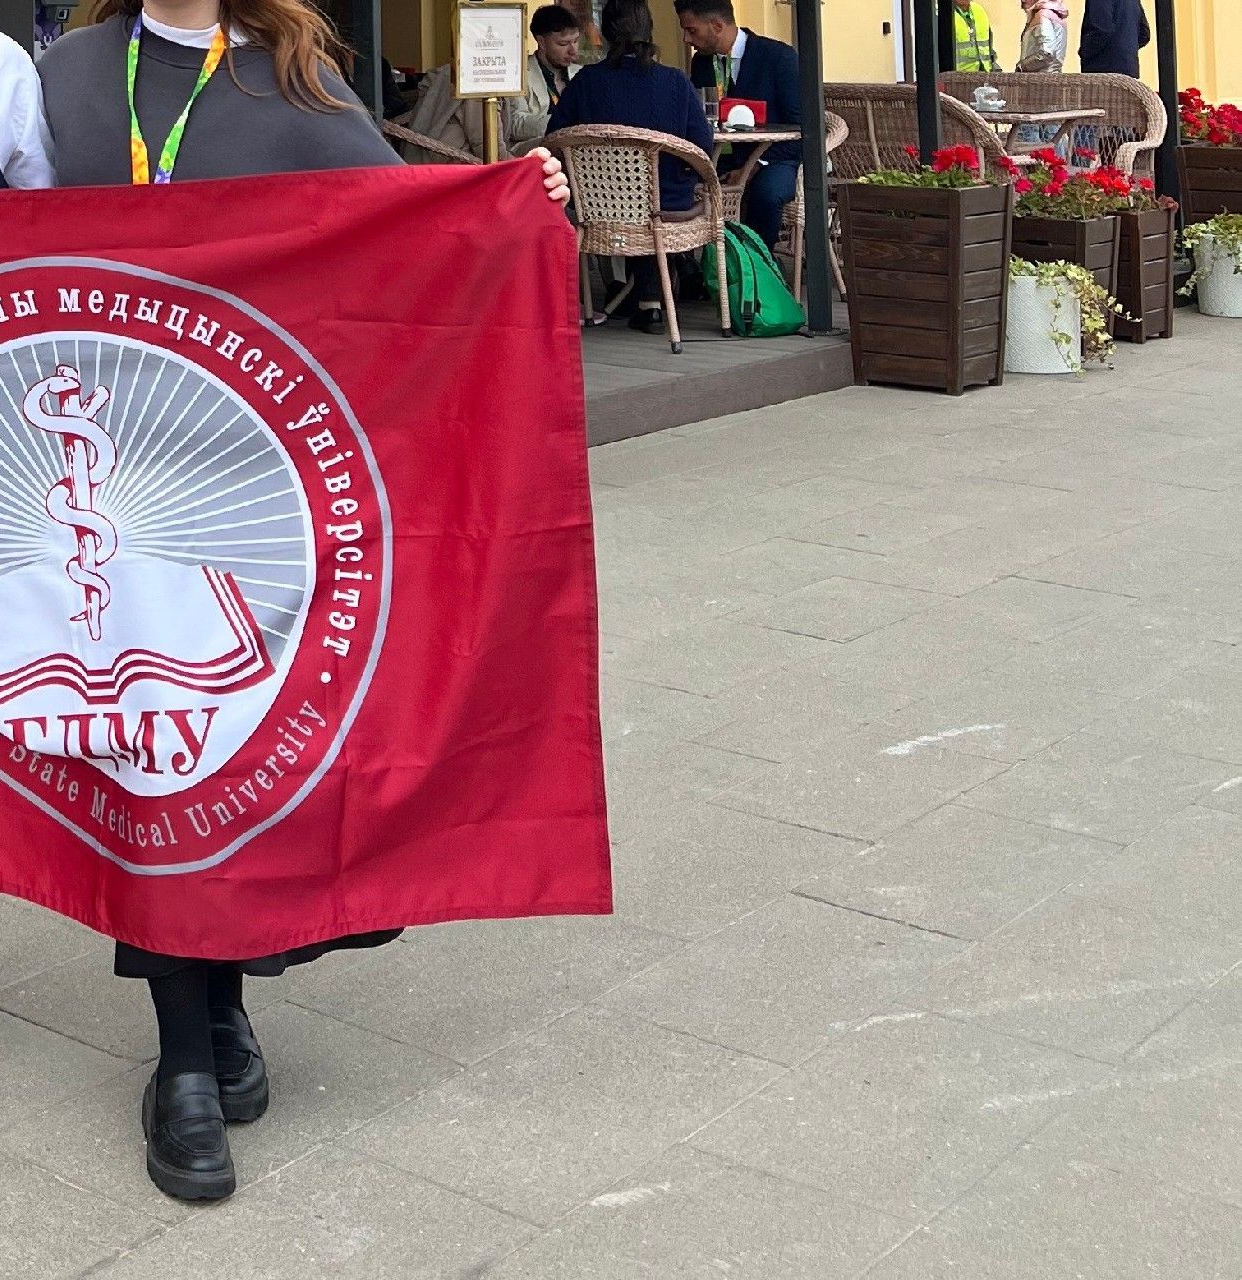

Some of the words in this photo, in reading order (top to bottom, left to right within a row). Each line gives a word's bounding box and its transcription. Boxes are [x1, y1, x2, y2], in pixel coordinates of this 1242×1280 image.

[57, 287, 303, 404] медыцынскі
[287, 402, 372, 657] ўніверсітэт
[90, 786, 178, 847] Medical
[184, 700, 326, 837] University
